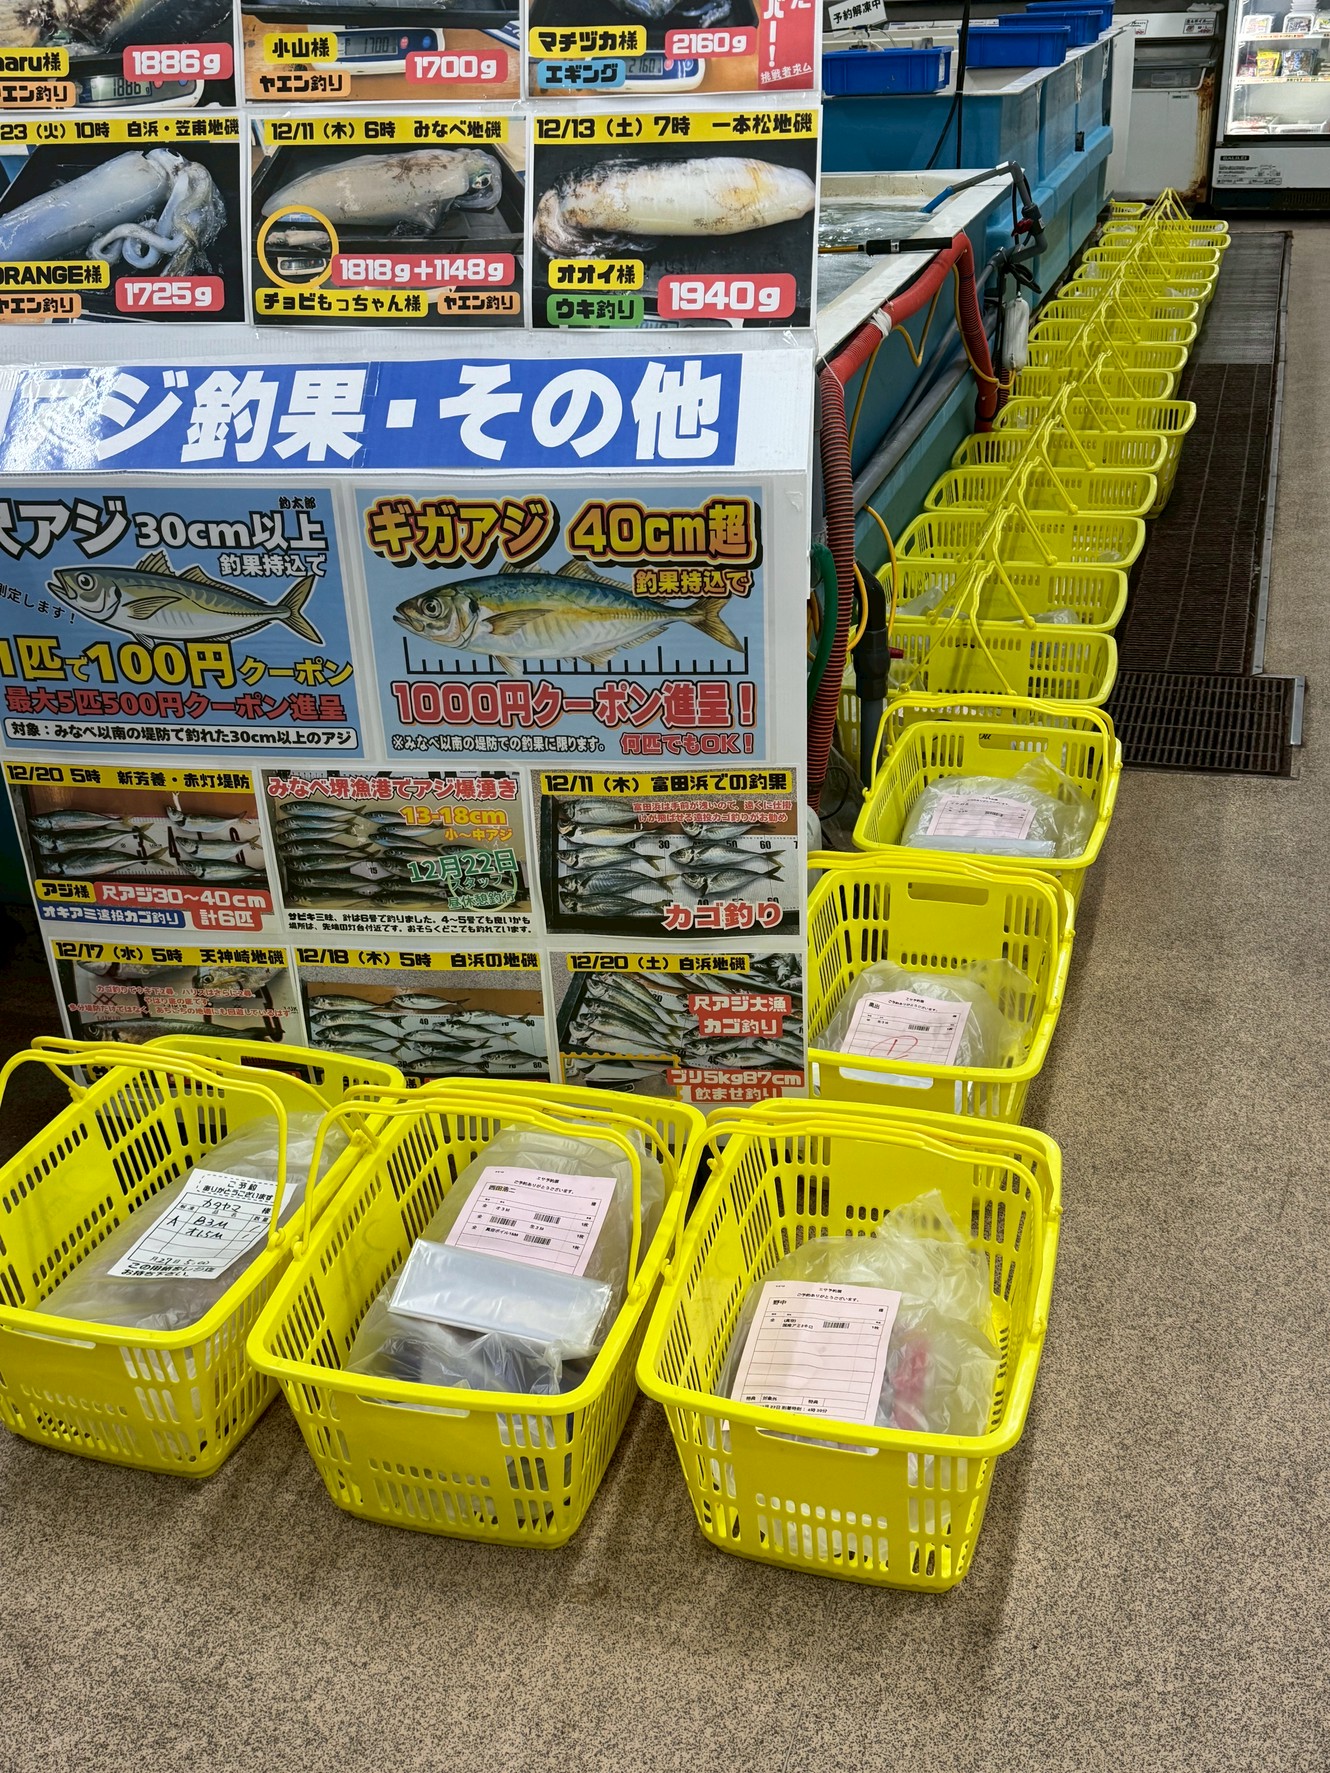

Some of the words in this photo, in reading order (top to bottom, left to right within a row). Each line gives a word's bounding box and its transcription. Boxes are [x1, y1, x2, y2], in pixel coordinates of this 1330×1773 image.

[272, 38, 329, 57] 小山様
[538, 31, 638, 52] マチヅカ様
[673, 33, 747, 54] 2160g
[132, 50, 221, 75] 1886g
[415, 56, 497, 79] 1700g
[761, 62, 812, 83] 挑戦者求ム
[260, 74, 343, 92] ヤエン釣り
[546, 63, 618, 84] エギング
[0, 85, 67, 102] エン釣り
[414, 121, 501, 138] みなべ地磯
[712, 113, 812, 134] 一本松地磯
[557, 264, 636, 284] オオイ様
[125, 283, 213, 307] 1725g
[263, 293, 421, 312] チョビもっちゃん様
[443, 295, 514, 311] ヤエン釣り
[670, 281, 780, 312] 1940g
[556, 299, 634, 320] ウキ釣り
[279, 495, 317, 510] 釣太郎
[134, 511, 329, 551] 30cm以上
[368, 497, 553, 562] ギガアジ
[571, 498, 755, 561] 40cm超
[219, 554, 326, 577] 釣果持込で
[633, 568, 752, 597] 釣果持込で
[5, 687, 347, 720] 最大5匹500円クーポン進呈
[391, 680, 757, 728] 1000円クーポン進呈！
[620, 734, 754, 755] 何匹でもOK！
[8, 765, 63, 782] 12/20
[267, 776, 518, 800] みなべ堺漁港でアジ爆湧き
[400, 805, 509, 826] 13-18cm
[407, 848, 519, 882] 12月22日
[42, 882, 90, 899] アジ様
[450, 874, 503, 891] スタッフ
[43, 905, 179, 926] オキアミ遠投カゴ釣り
[200, 910, 255, 927] 計6匹
[663, 901, 784, 930] カゴ釣り
[200, 949, 284, 965] 天神崎地磯
[451, 953, 538, 968] 白浜の地磯
[693, 996, 788, 1013] 尺アジ大漁
[704, 1018, 777, 1035] カゴ釣り
[670, 1070, 801, 1086] ブリ5kg87cm
[695, 1088, 778, 1100] 飲ませ釣り
